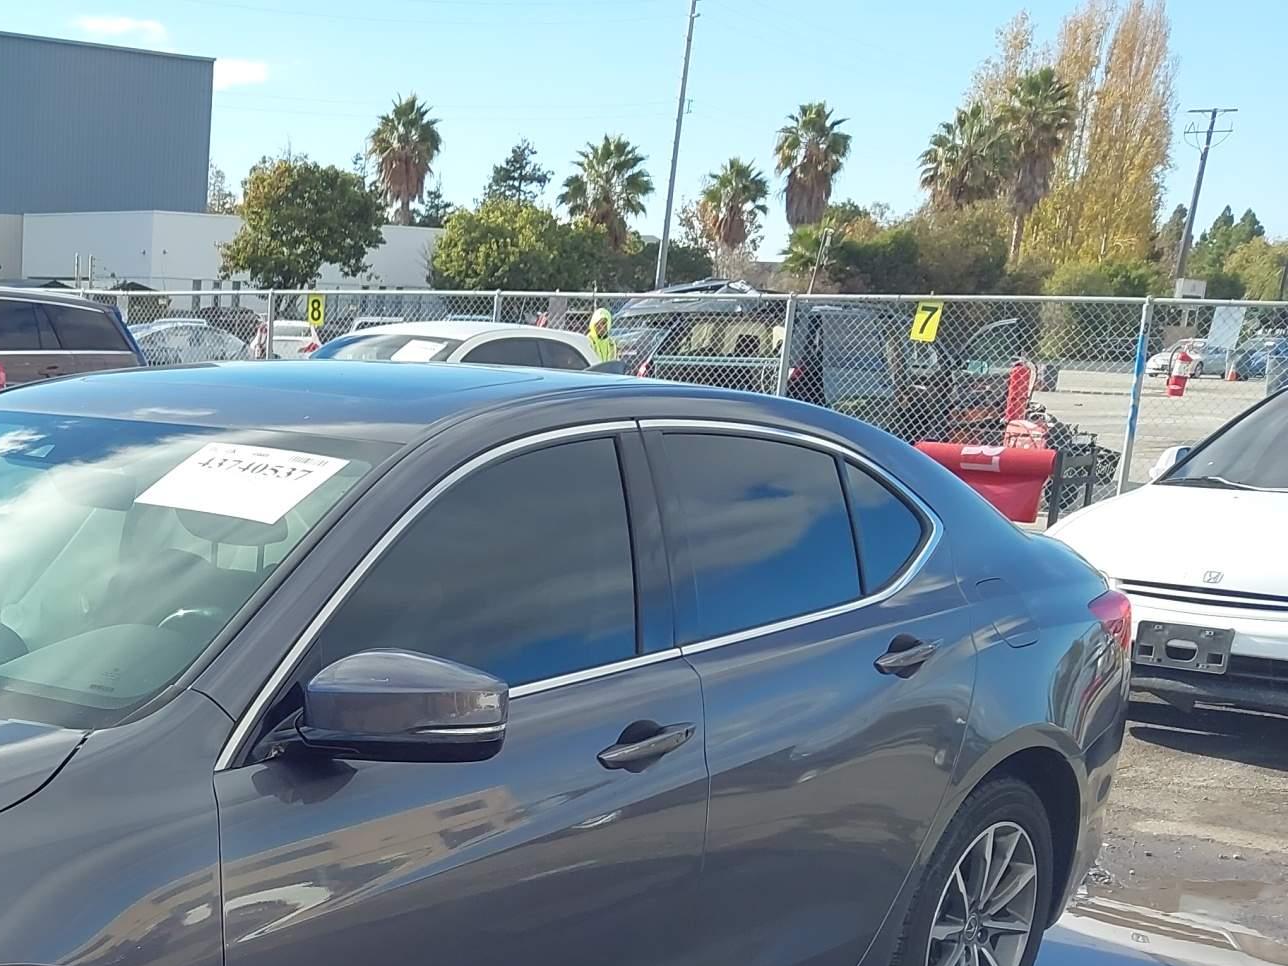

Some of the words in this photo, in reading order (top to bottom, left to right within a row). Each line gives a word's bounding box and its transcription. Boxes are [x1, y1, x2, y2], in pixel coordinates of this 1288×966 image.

[310, 298, 322, 322] 8
[919, 305, 939, 335] 7
[198, 456, 314, 481] 43740537
